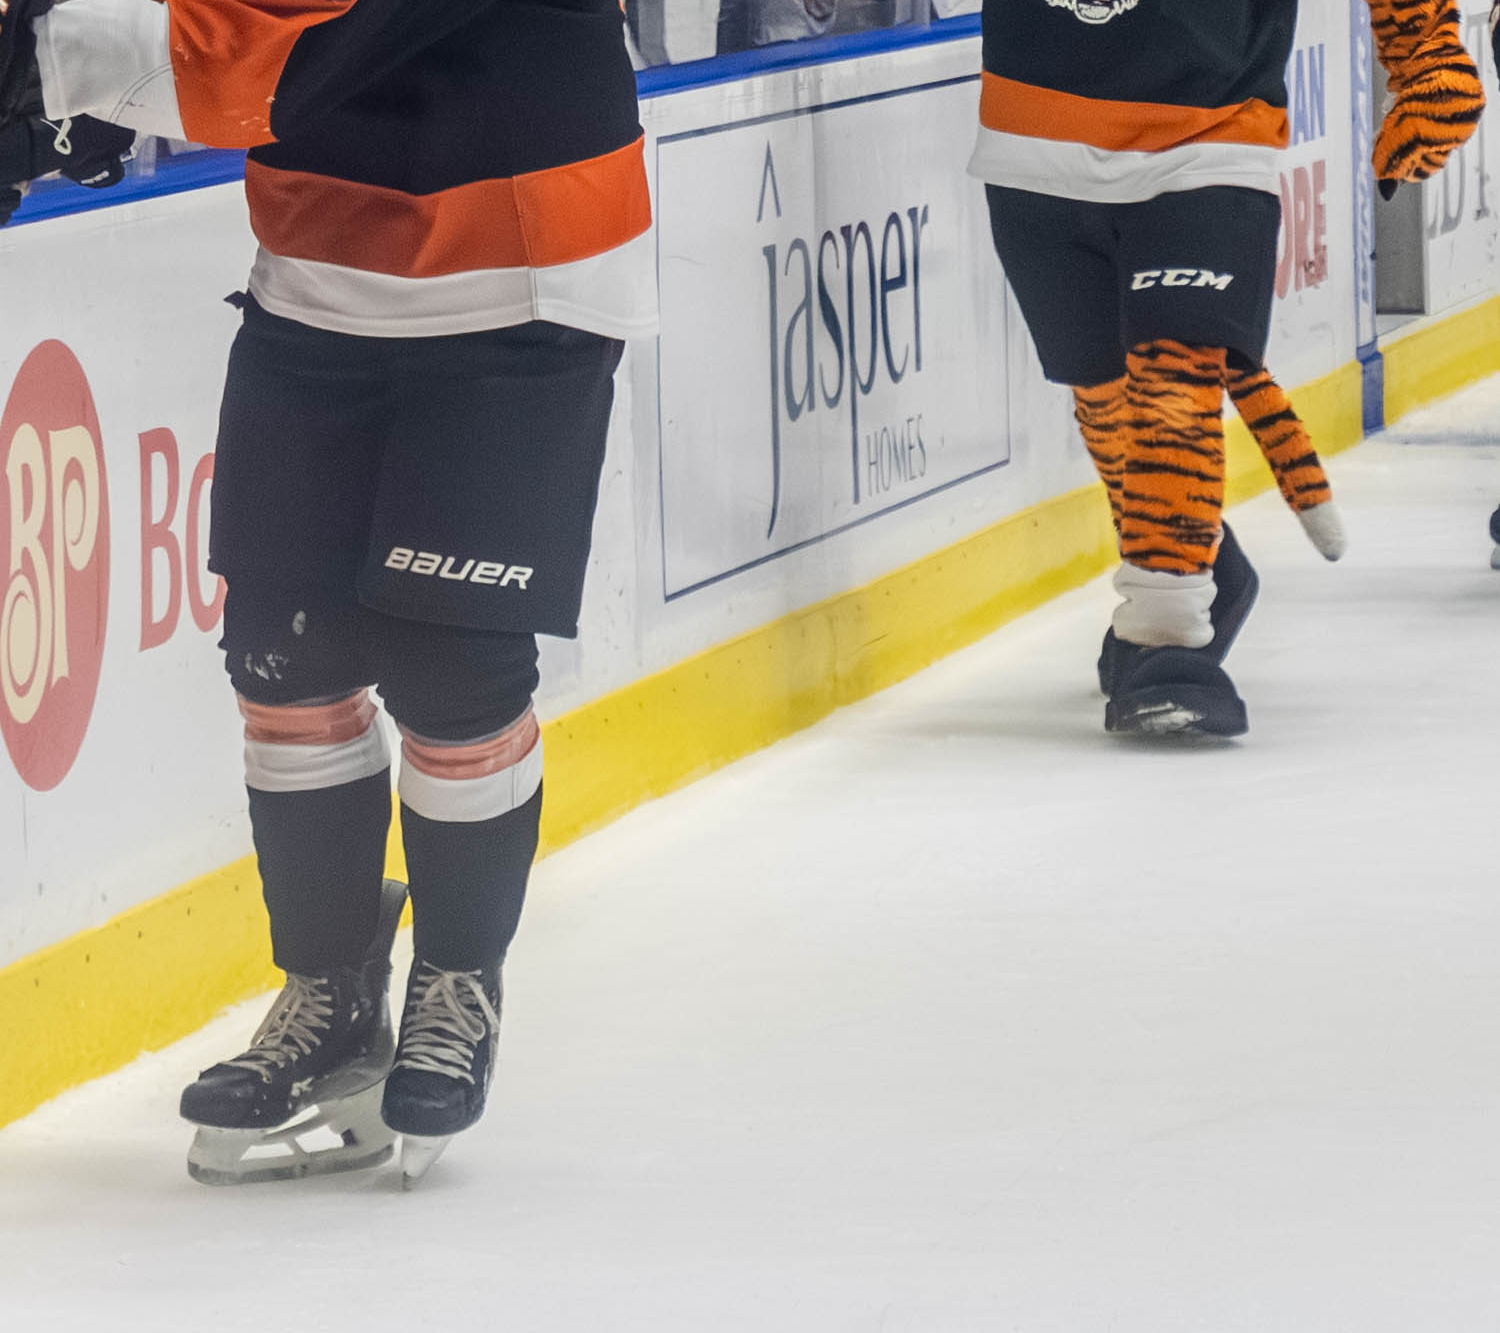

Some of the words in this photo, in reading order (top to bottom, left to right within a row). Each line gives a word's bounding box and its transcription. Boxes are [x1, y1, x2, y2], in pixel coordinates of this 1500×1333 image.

[1131, 268, 1235, 293] CCM
[761, 203, 930, 541] jasper
[866, 411, 928, 499] HOMES
[0, 422, 98, 725] BP
[138, 425, 227, 655] Bo
[385, 545, 535, 591] BAUER
